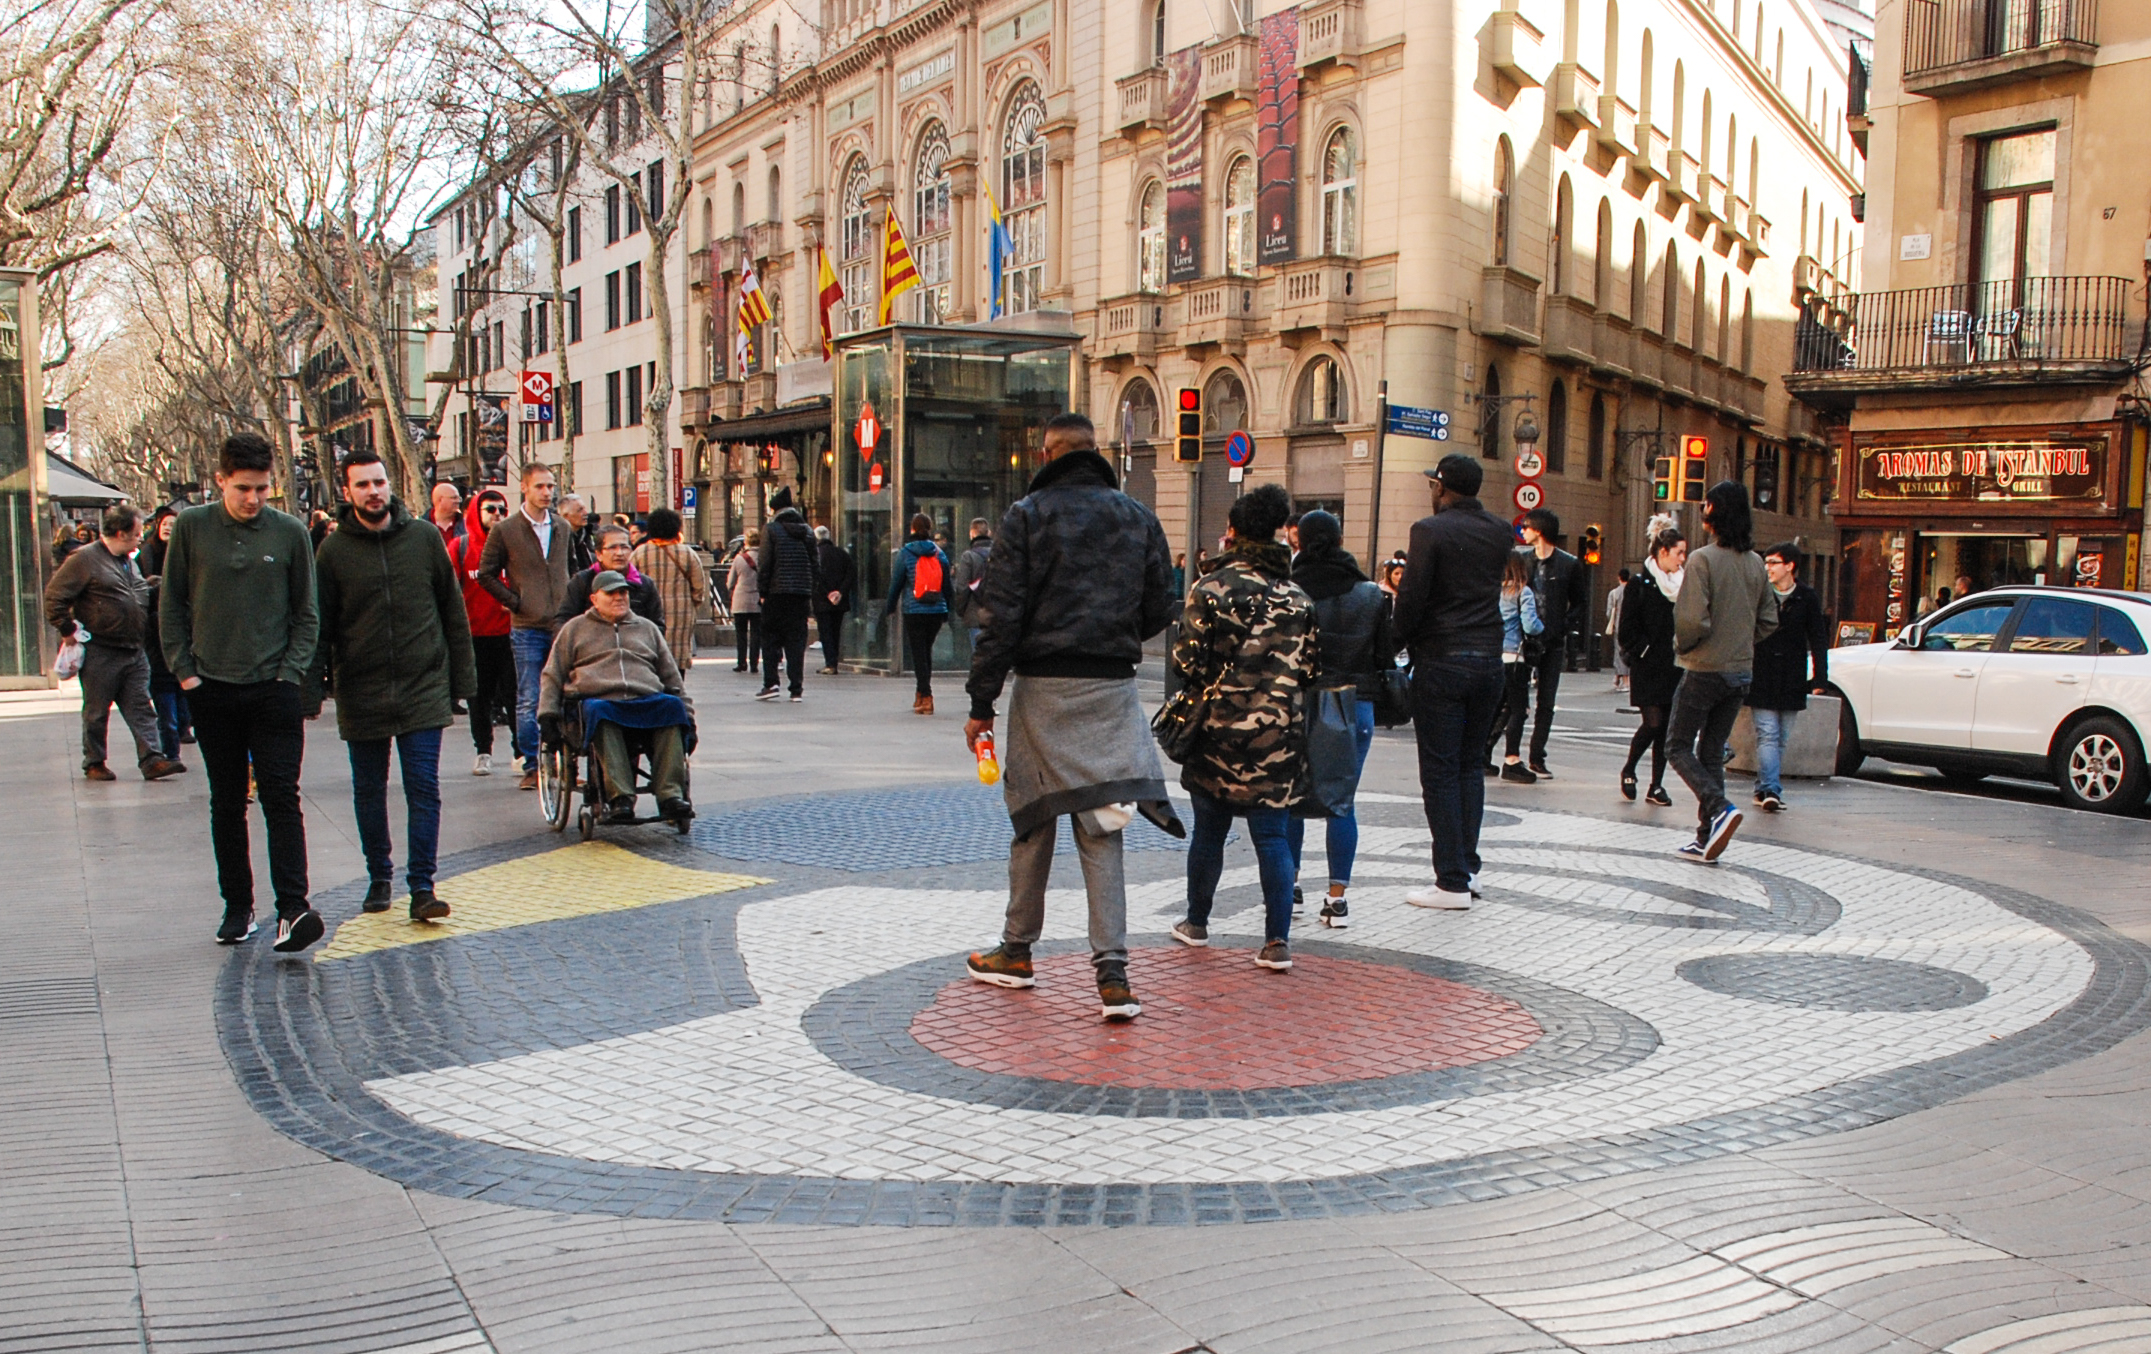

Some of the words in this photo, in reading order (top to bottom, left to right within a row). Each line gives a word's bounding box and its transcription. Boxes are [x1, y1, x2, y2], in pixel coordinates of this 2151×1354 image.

[2103, 207, 2117, 220] 67
[532, 379, 543, 391] M
[861, 418, 874, 448] M
[1877, 451, 1952, 480] AROMAS
[1961, 450, 1987, 477] DE
[1996, 448, 2090, 487] ISTANBUL
[2012, 481, 2043, 493] GRILL
[684, 489, 694, 506] P
[1522, 491, 1536, 502] 10
